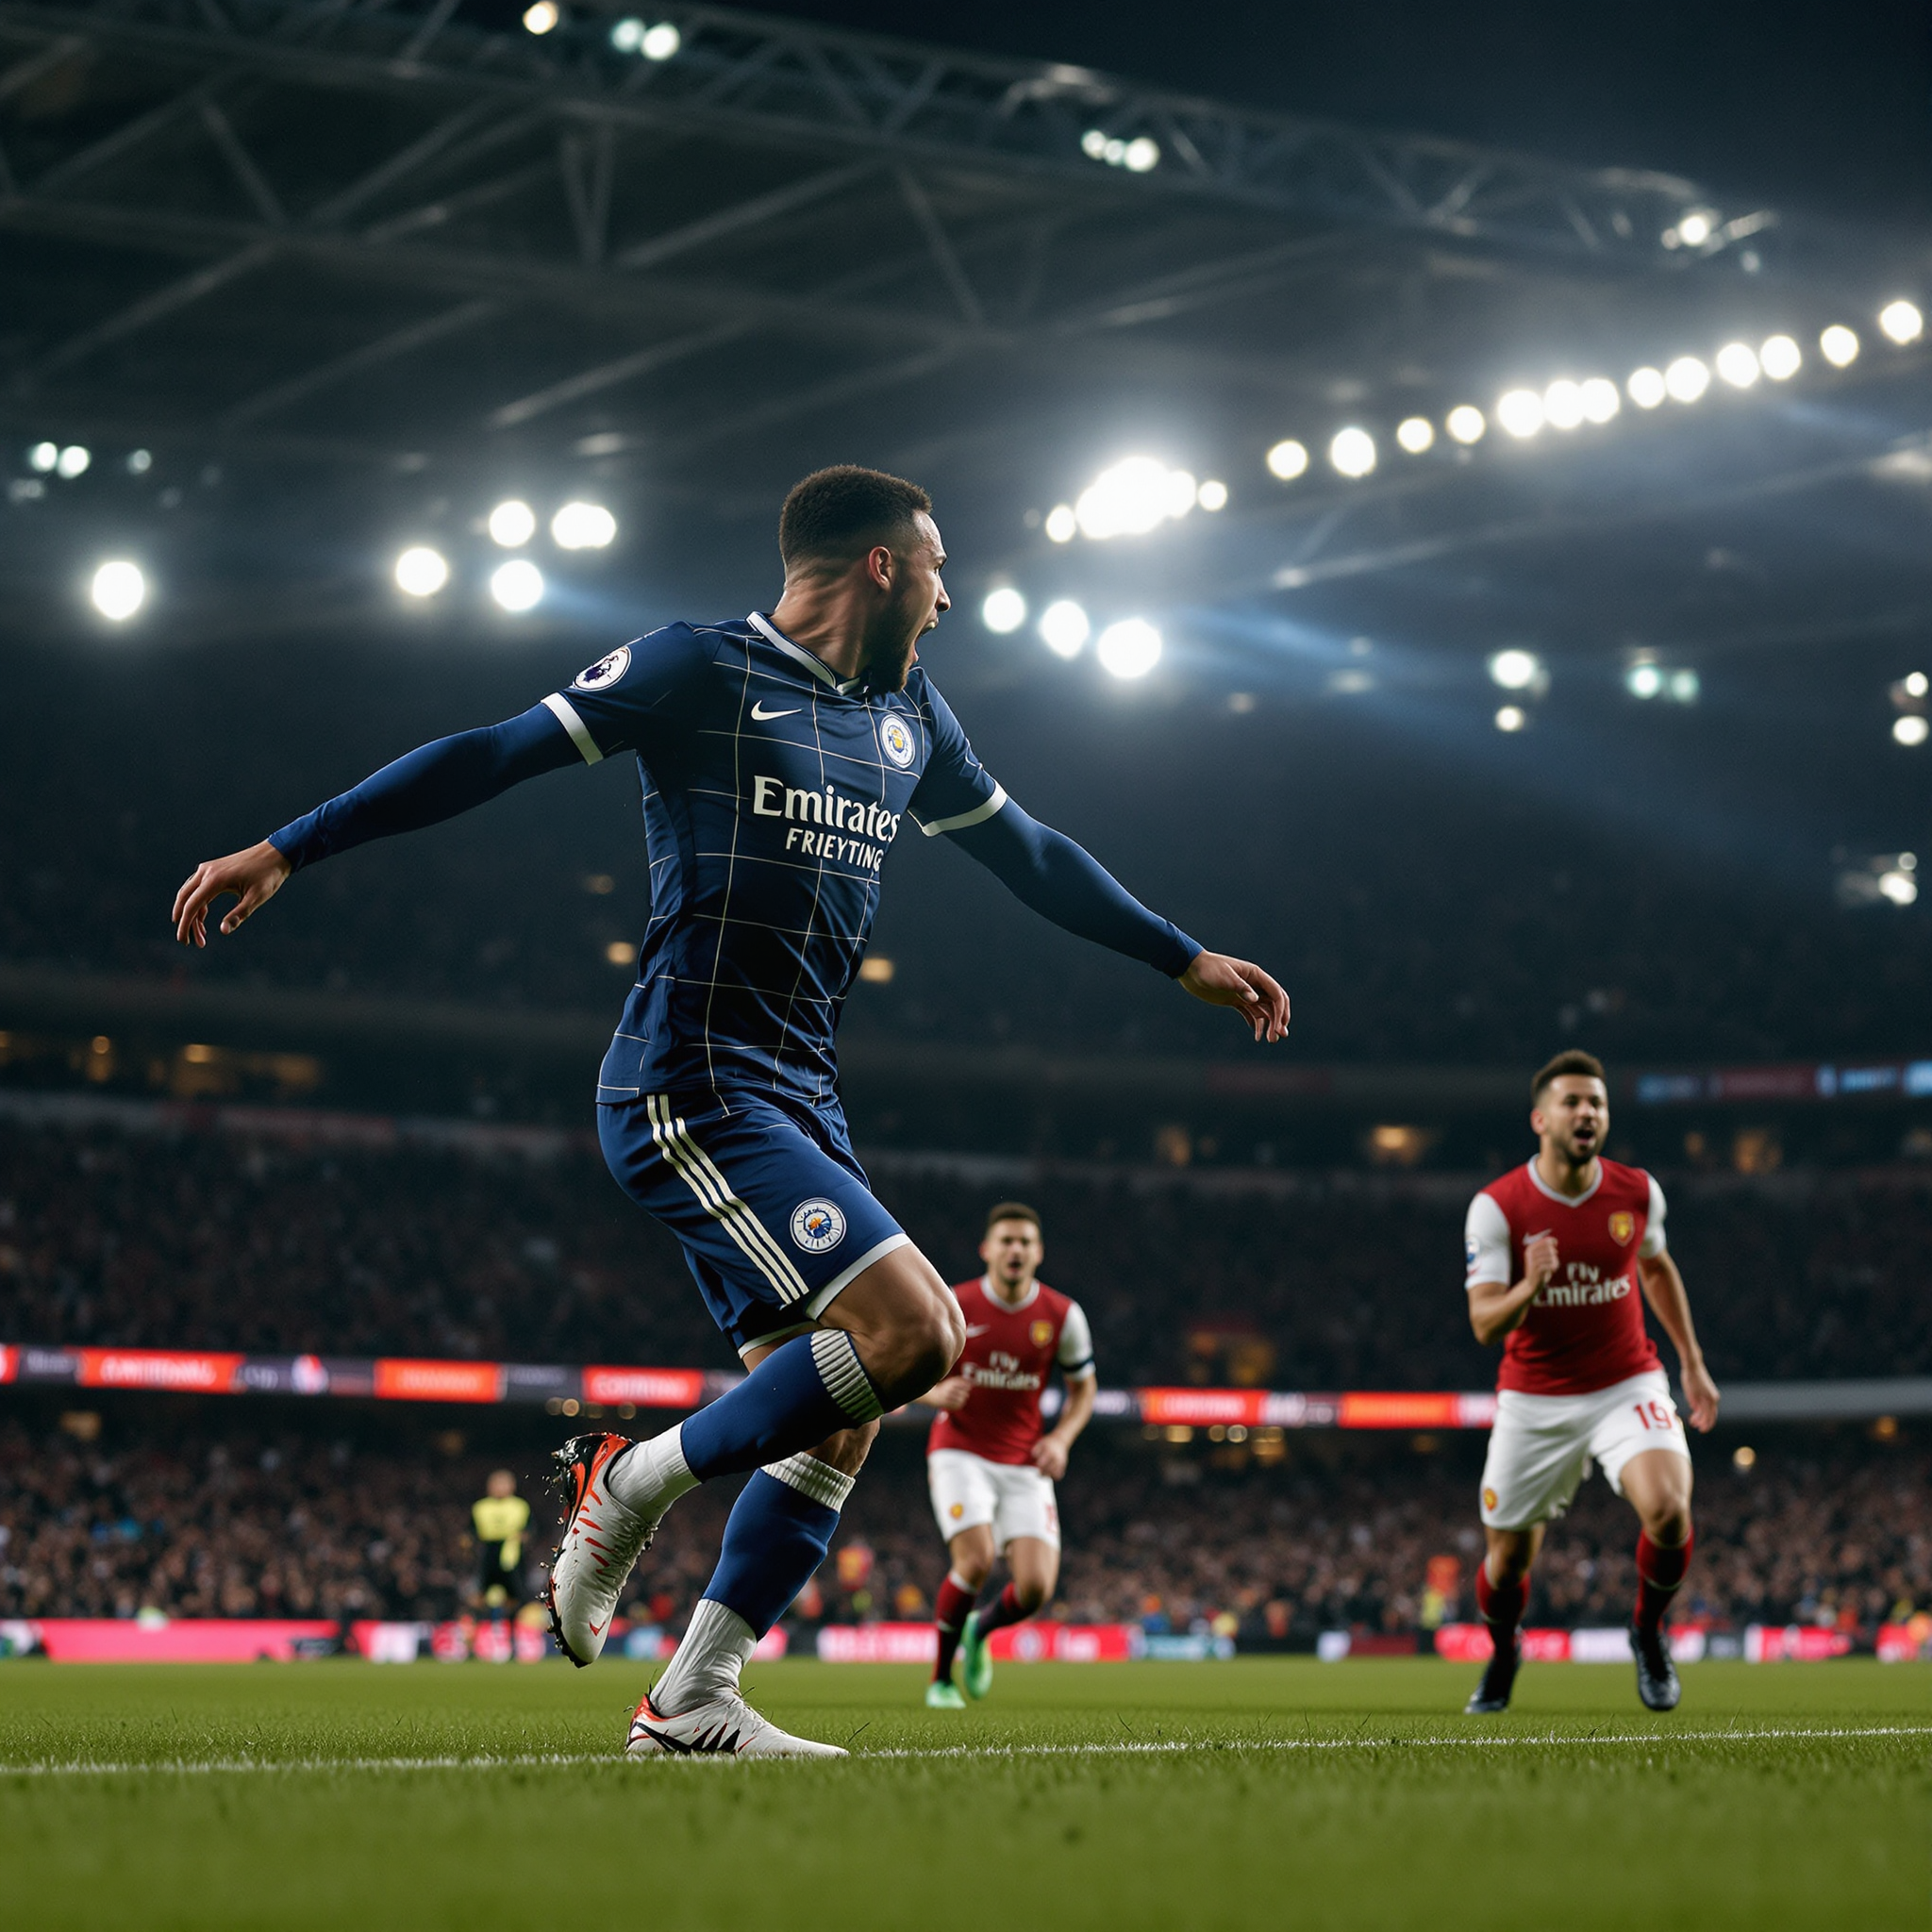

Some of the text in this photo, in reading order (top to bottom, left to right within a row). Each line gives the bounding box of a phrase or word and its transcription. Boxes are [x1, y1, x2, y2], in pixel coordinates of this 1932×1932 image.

[753, 774, 901, 842] Emirates
[1567, 1261, 1600, 1283] Fly
[1633, 1402, 1672, 1430] 19
